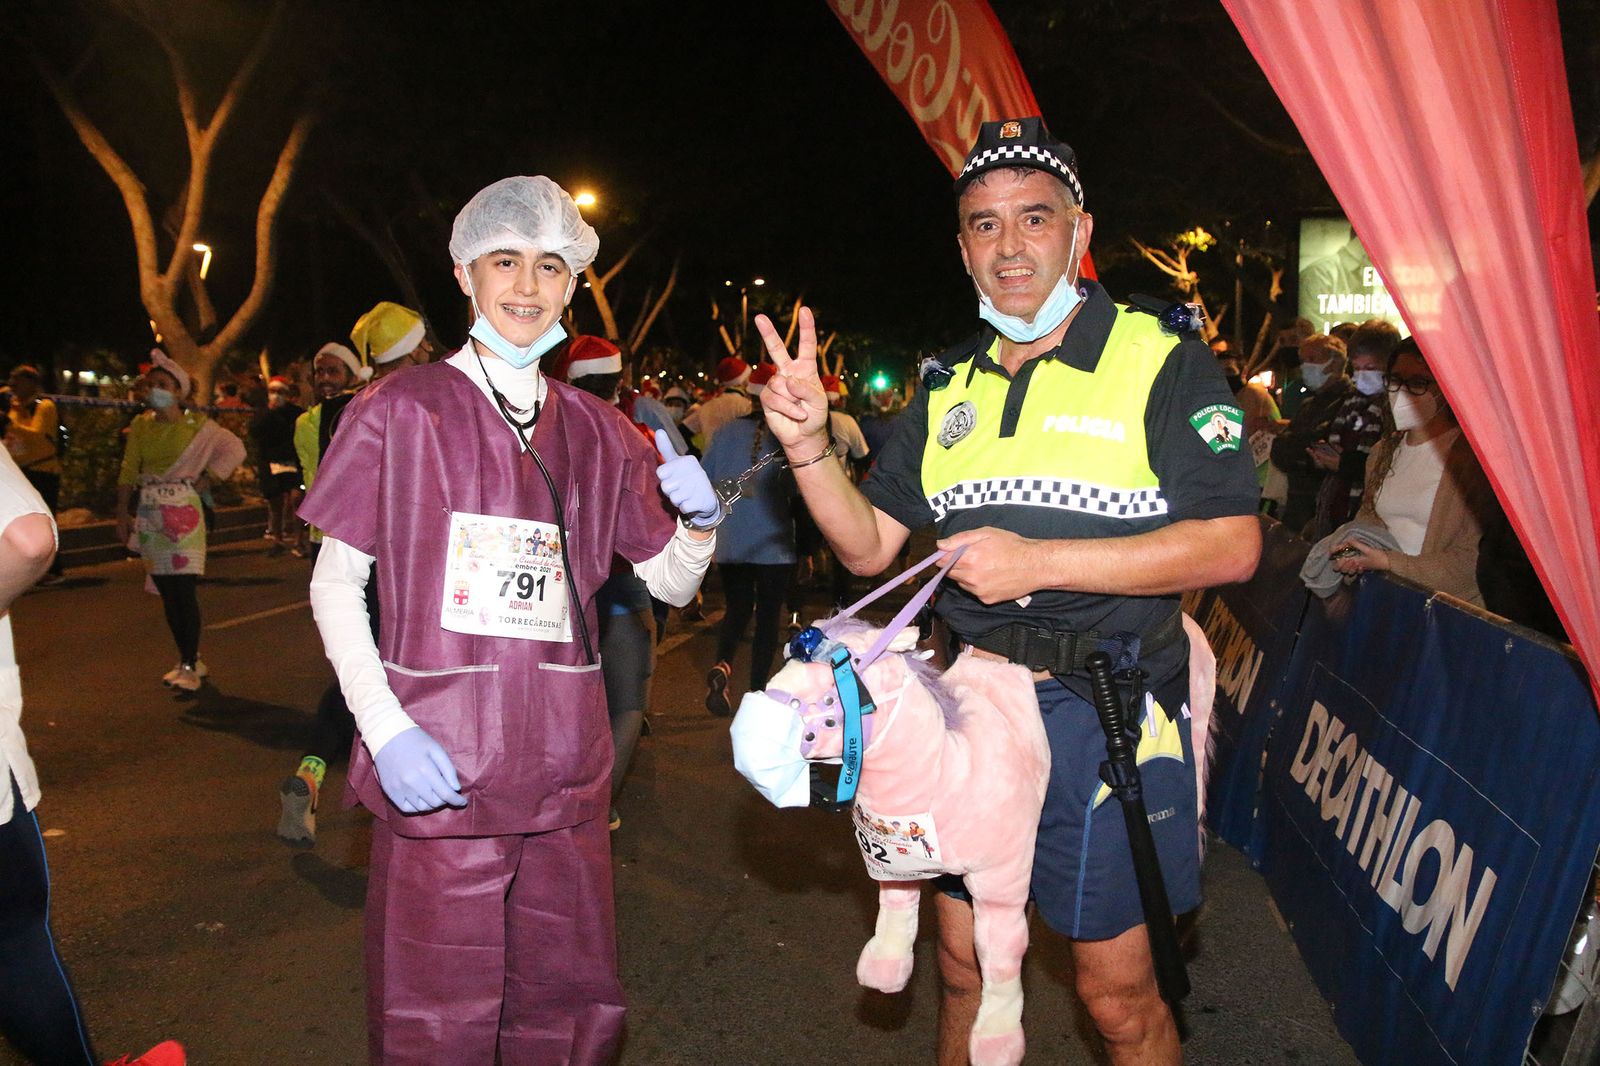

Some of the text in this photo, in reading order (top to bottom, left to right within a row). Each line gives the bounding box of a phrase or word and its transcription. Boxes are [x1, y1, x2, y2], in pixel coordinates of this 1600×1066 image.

[1193, 405, 1240, 421] POLICIA LOCAL
[1043, 415, 1125, 442] POLICIA
[497, 570, 546, 601] 791
[508, 600, 533, 611] ADRIAN
[1290, 700, 1498, 992] DECATHLON
